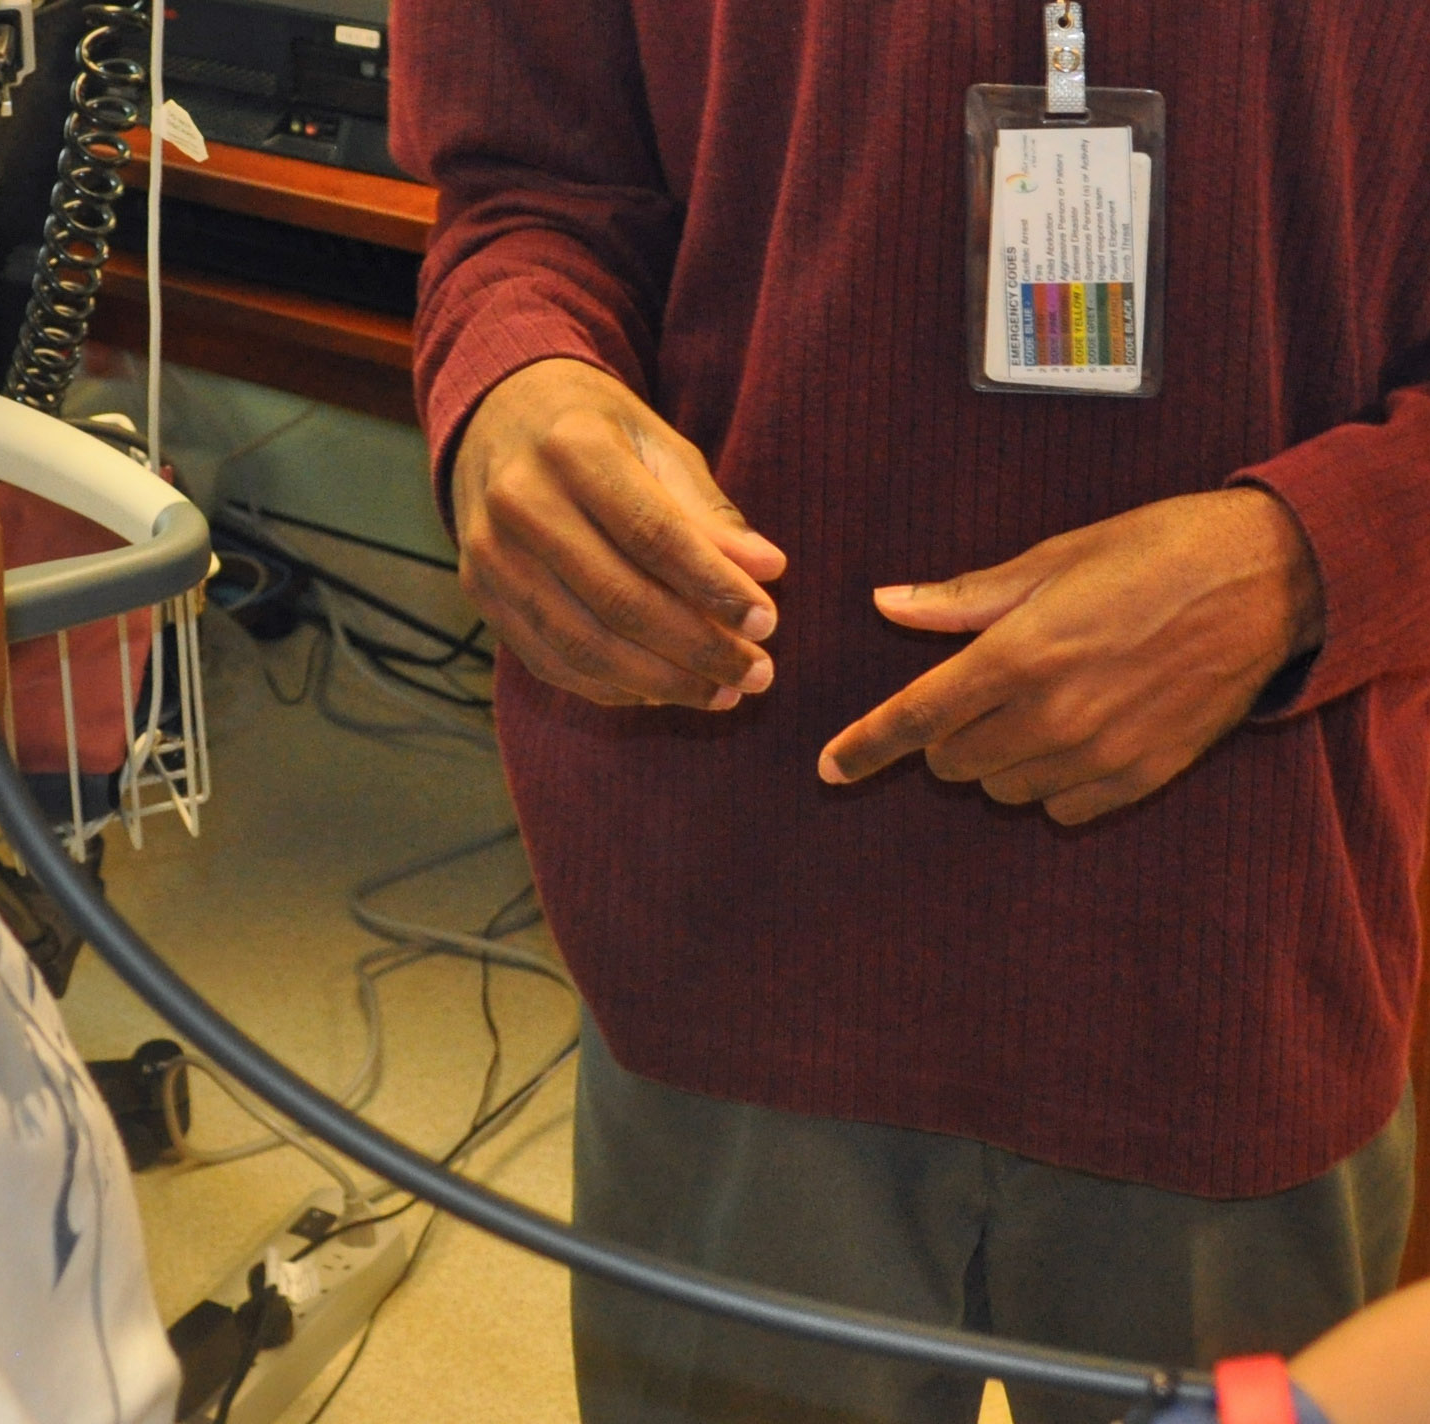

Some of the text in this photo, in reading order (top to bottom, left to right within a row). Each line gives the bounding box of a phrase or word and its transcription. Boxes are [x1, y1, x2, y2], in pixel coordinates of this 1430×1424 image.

[1081, 139, 1091, 170] Activity
[1082, 174, 1090, 183] or
[1055, 153, 1069, 281] Aggressive Person or Patient
[1070, 206, 1080, 280] External Disaster
[1082, 199, 1091, 230] Person
[1095, 187, 1107, 280] Rapid response team
[1108, 200, 1118, 280] Patient Elopement
[1021, 219, 1031, 281] Cardiac Arrest
[1035, 264, 1043, 281] Fire
[1045, 213, 1055, 281] Child Abduction
[1085, 234, 1094, 280] Suspicious
[1121, 223, 1131, 280] Bomb Threat
[1007, 246, 1021, 366] EMERGENCY CODES
[1023, 308, 1035, 364] CODE BLUE
[1073, 291, 1084, 364] CODE YELLOW
[1085, 307, 1096, 364] CODE GREY
[1123, 299, 1135, 364] CODE BLACK
